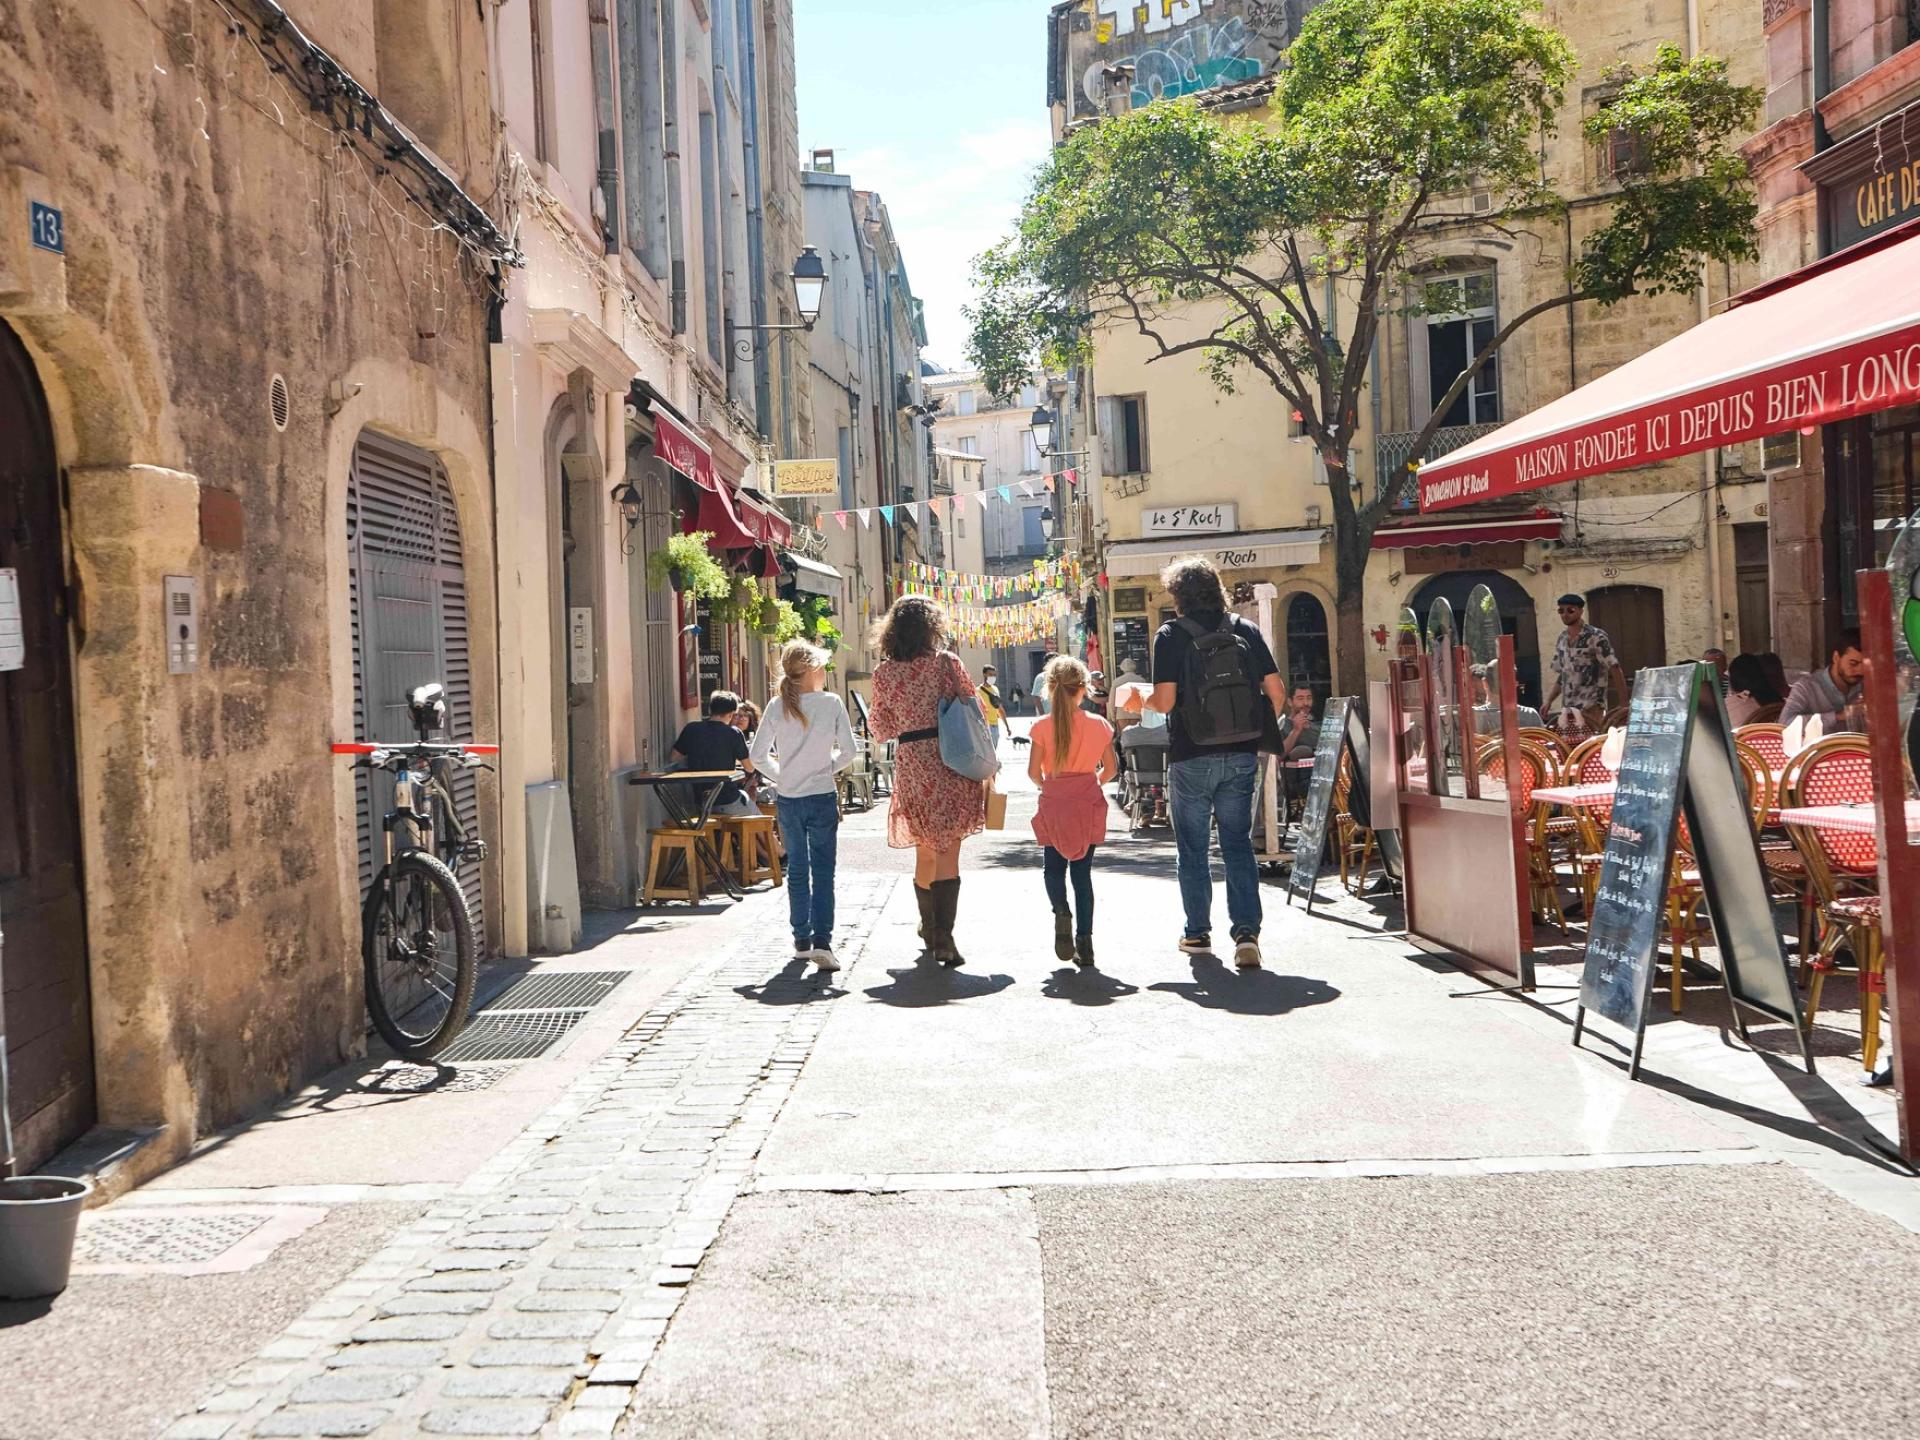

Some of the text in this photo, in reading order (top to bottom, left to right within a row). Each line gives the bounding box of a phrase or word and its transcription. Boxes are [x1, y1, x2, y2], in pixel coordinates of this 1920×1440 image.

[1857, 172, 1896, 228] CAFE
[36, 210, 59, 246] 13
[1515, 344, 1920, 484] MAISON FONDEE ICI DEPUIS BIEN LONG
[1470, 469, 1489, 494] Roch
[1153, 512, 1166, 527] Le
[1188, 506, 1222, 528] Roch
[1215, 550, 1257, 566] Roch
[1603, 567, 1617, 577] 20
